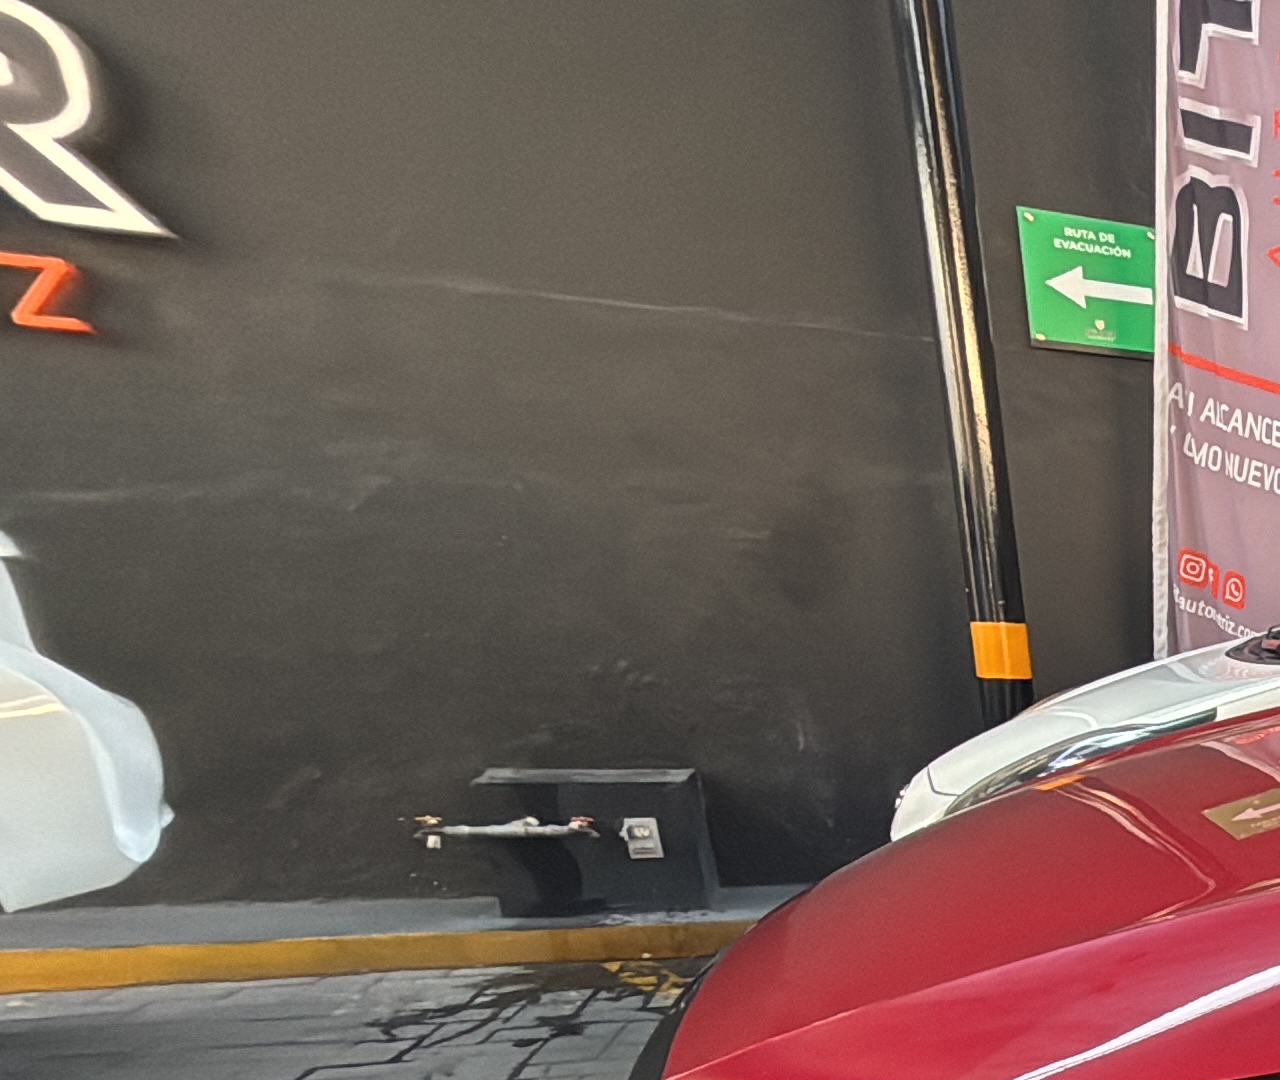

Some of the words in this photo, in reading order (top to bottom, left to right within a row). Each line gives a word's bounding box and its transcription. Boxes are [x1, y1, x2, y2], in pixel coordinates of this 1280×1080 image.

[1063, 226, 1096, 241] RUTA
[1099, 231, 1116, 244] DE
[1053, 237, 1132, 259] EVACUACIÓN
